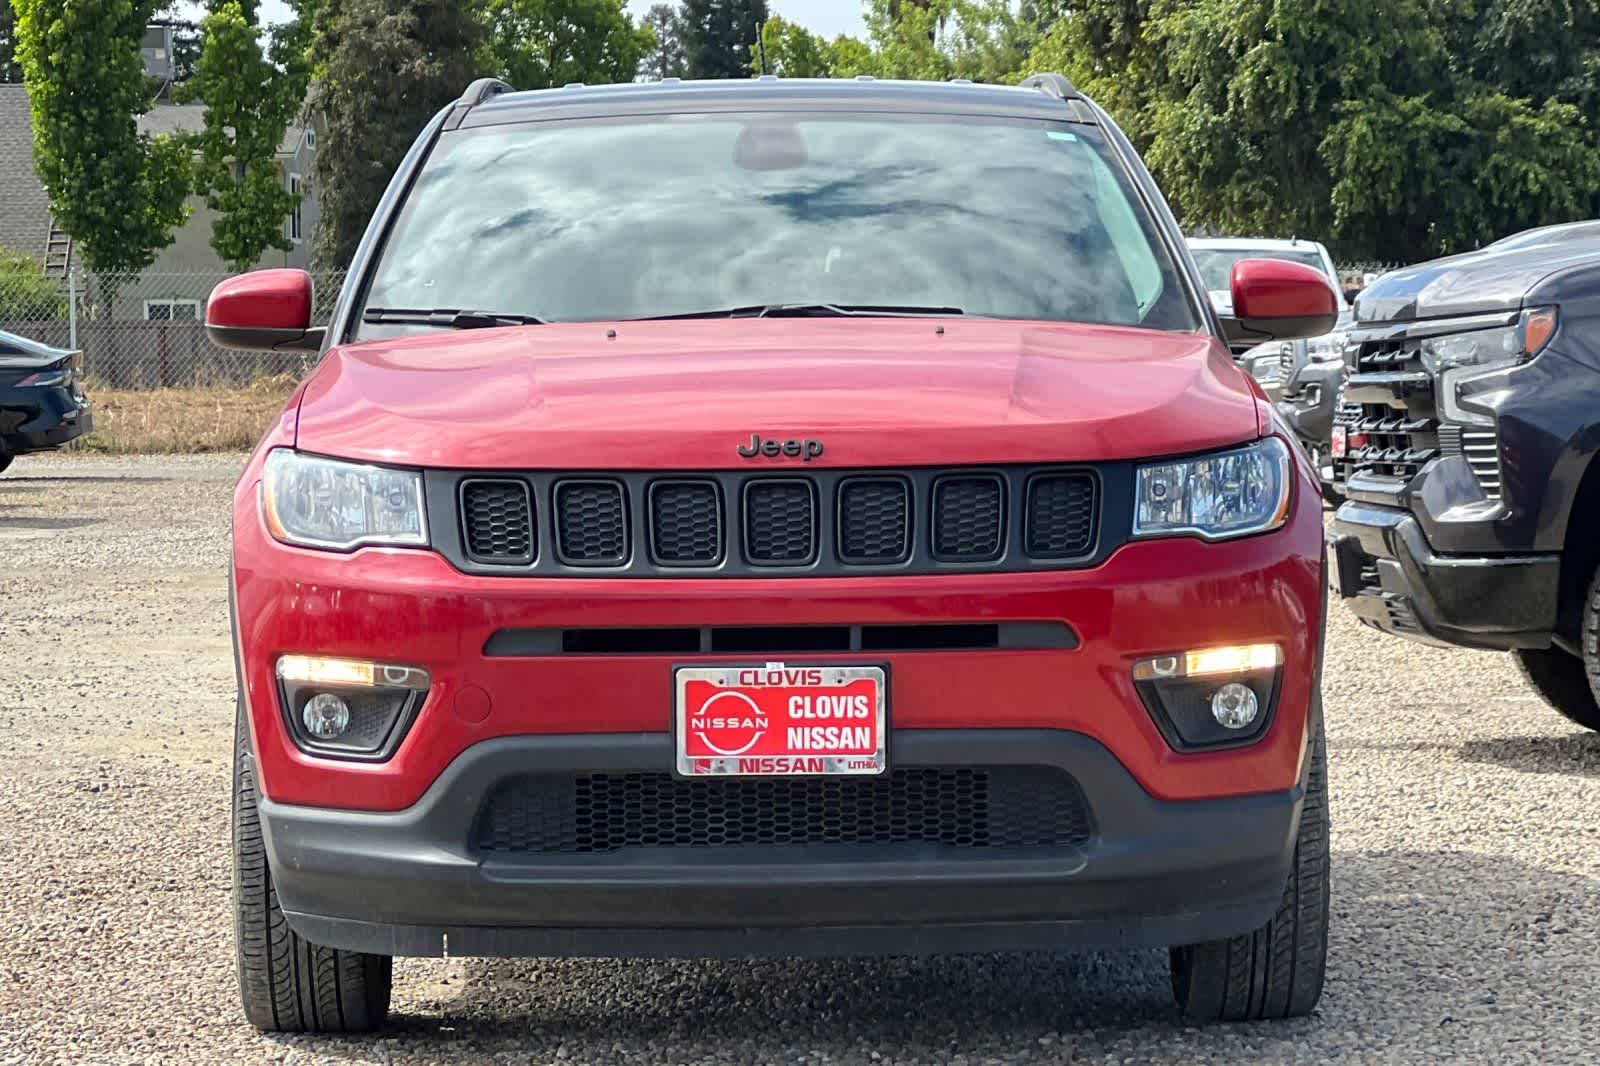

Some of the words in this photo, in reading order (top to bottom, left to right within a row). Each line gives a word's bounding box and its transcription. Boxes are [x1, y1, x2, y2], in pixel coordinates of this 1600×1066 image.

[737, 434, 824, 462] Jeep
[740, 670, 822, 686] CLOVIS
[788, 696, 869, 719] CLOVIS
[691, 718, 769, 729] NISSAN
[787, 727, 870, 750] NISSAN
[739, 758, 824, 773] NISSAN
